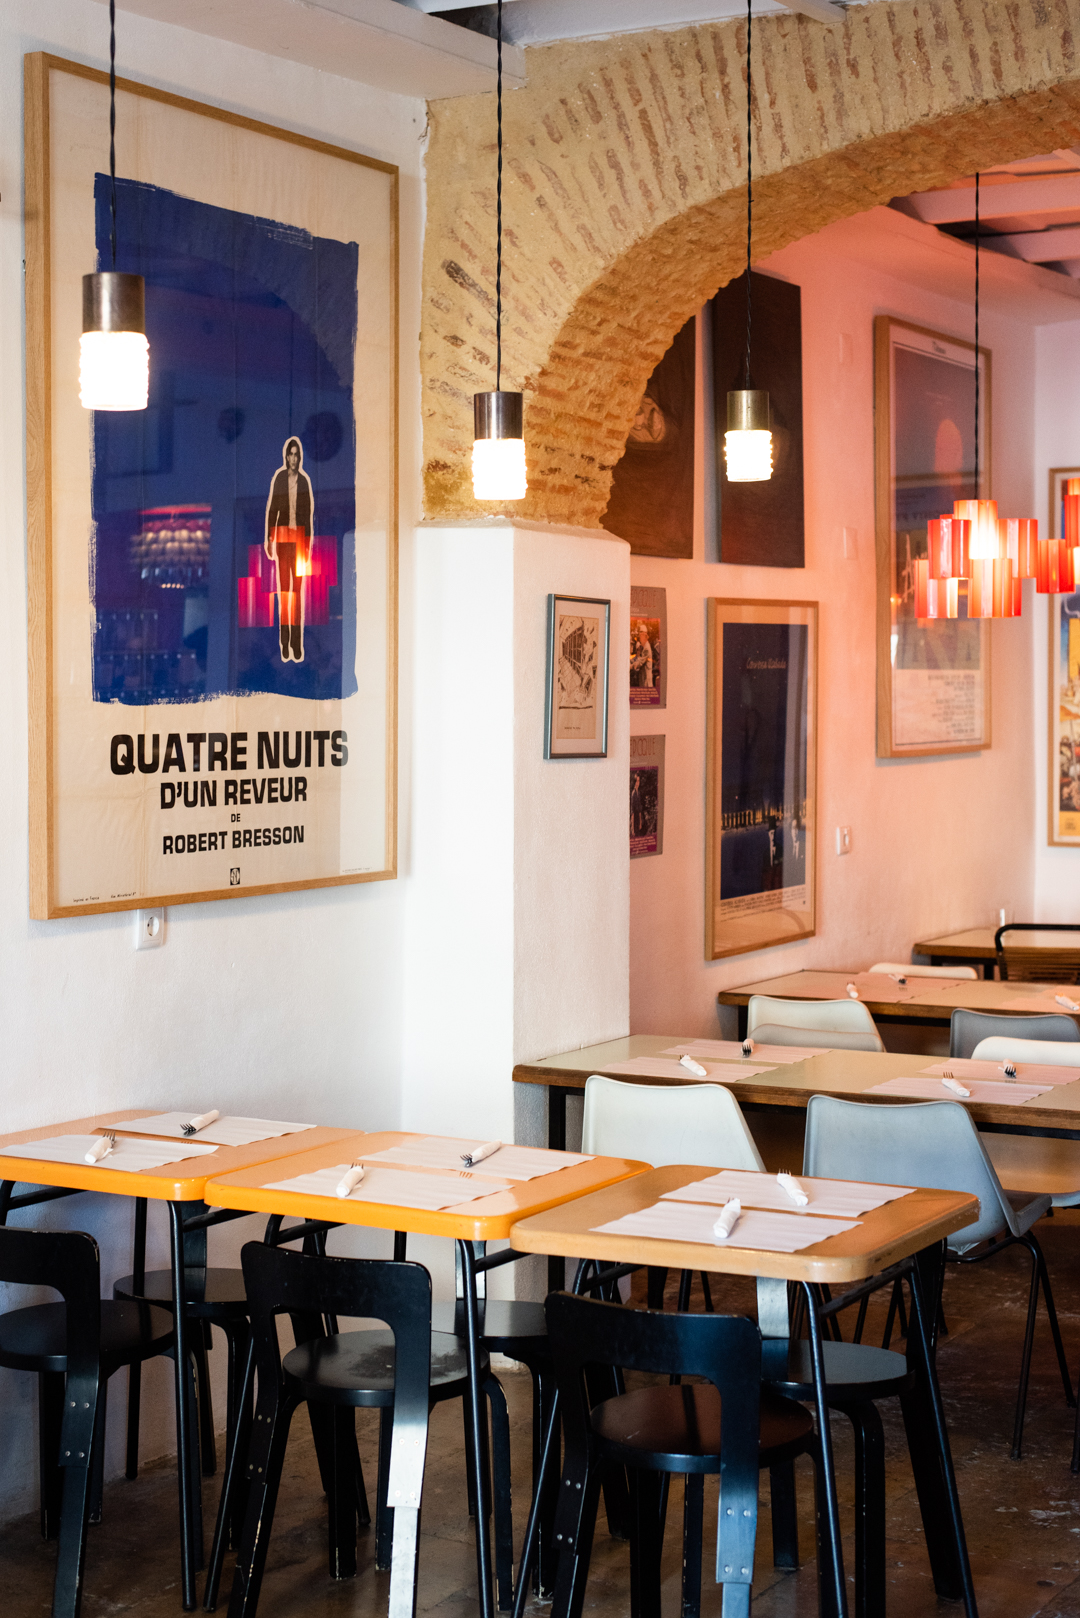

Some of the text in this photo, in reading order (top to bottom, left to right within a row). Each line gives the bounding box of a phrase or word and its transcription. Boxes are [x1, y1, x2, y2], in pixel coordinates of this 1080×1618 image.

[110, 730, 348, 775] QUATRE NUITS
[160, 776, 307, 809] D'UN REVEUR
[231, 813, 241, 823] DE
[163, 825, 304, 855] ROBERT BRESSON
